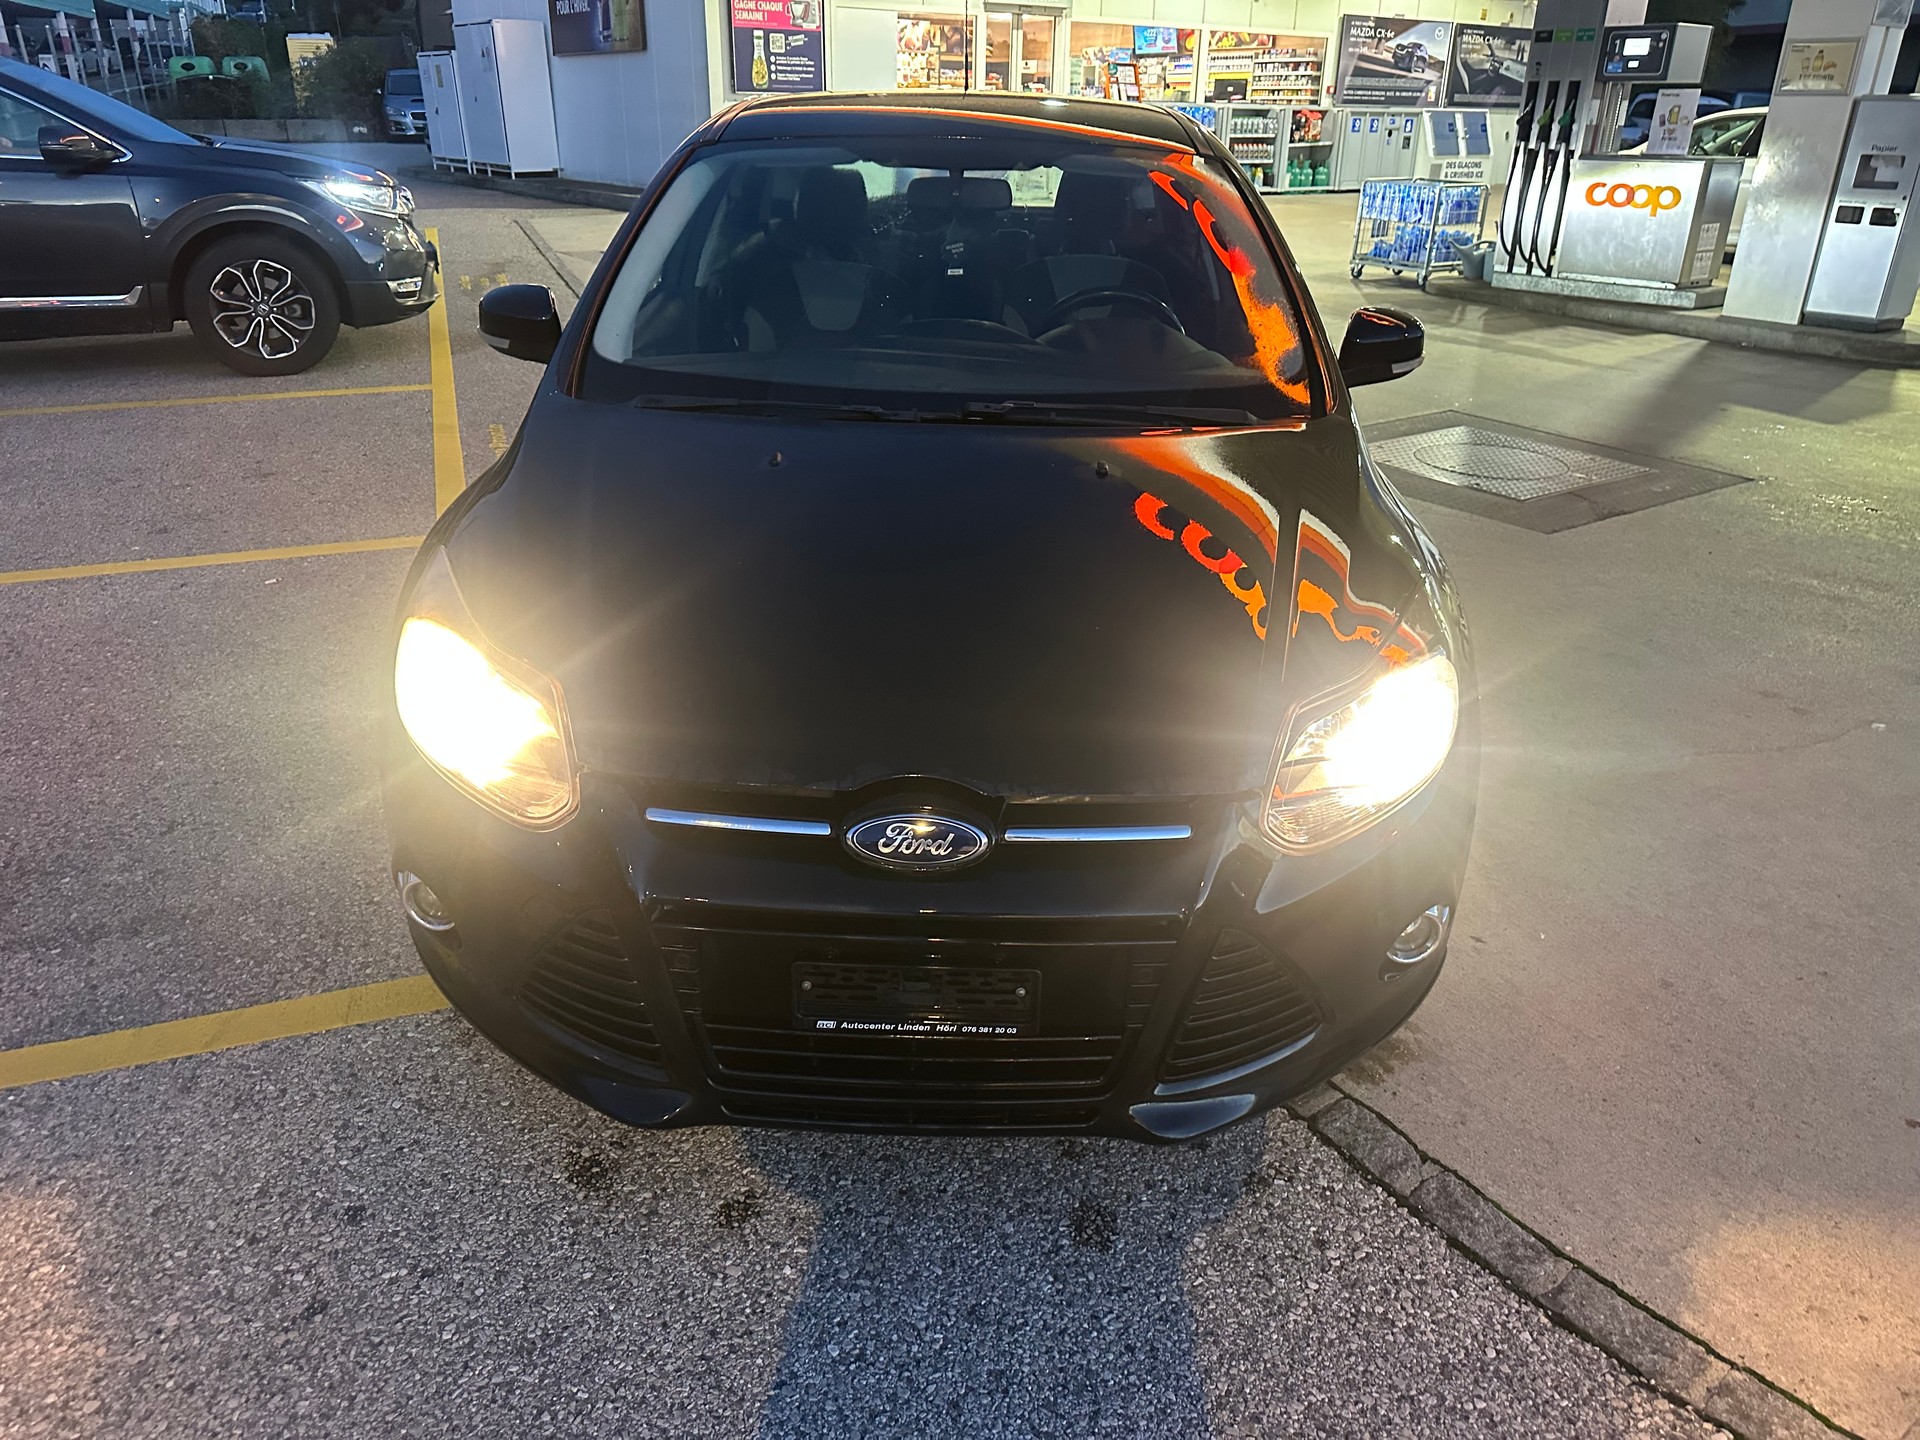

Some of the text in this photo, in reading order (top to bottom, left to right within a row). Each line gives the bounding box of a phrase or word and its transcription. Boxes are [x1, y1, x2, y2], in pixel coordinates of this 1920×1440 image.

[556, 0, 570, 15] POUR
[734, 0, 783, 12] GAGNE CHAQUE
[735, 10, 764, 21] SEMAINE
[1349, 27, 1375, 37] MAZDA
[1462, 34, 1484, 44] MAZDA
[1871, 144, 1898, 153] Papier
[1445, 161, 1482, 170] DES GLAÇONS
[1450, 171, 1475, 179] CRUSHED
[1475, 170, 1484, 178] ICE
[1585, 182, 1682, 217] coop
[878, 823, 955, 855] Ford
[840, 1021, 895, 1030] Autocenter
[897, 1023, 931, 1032] Linden
